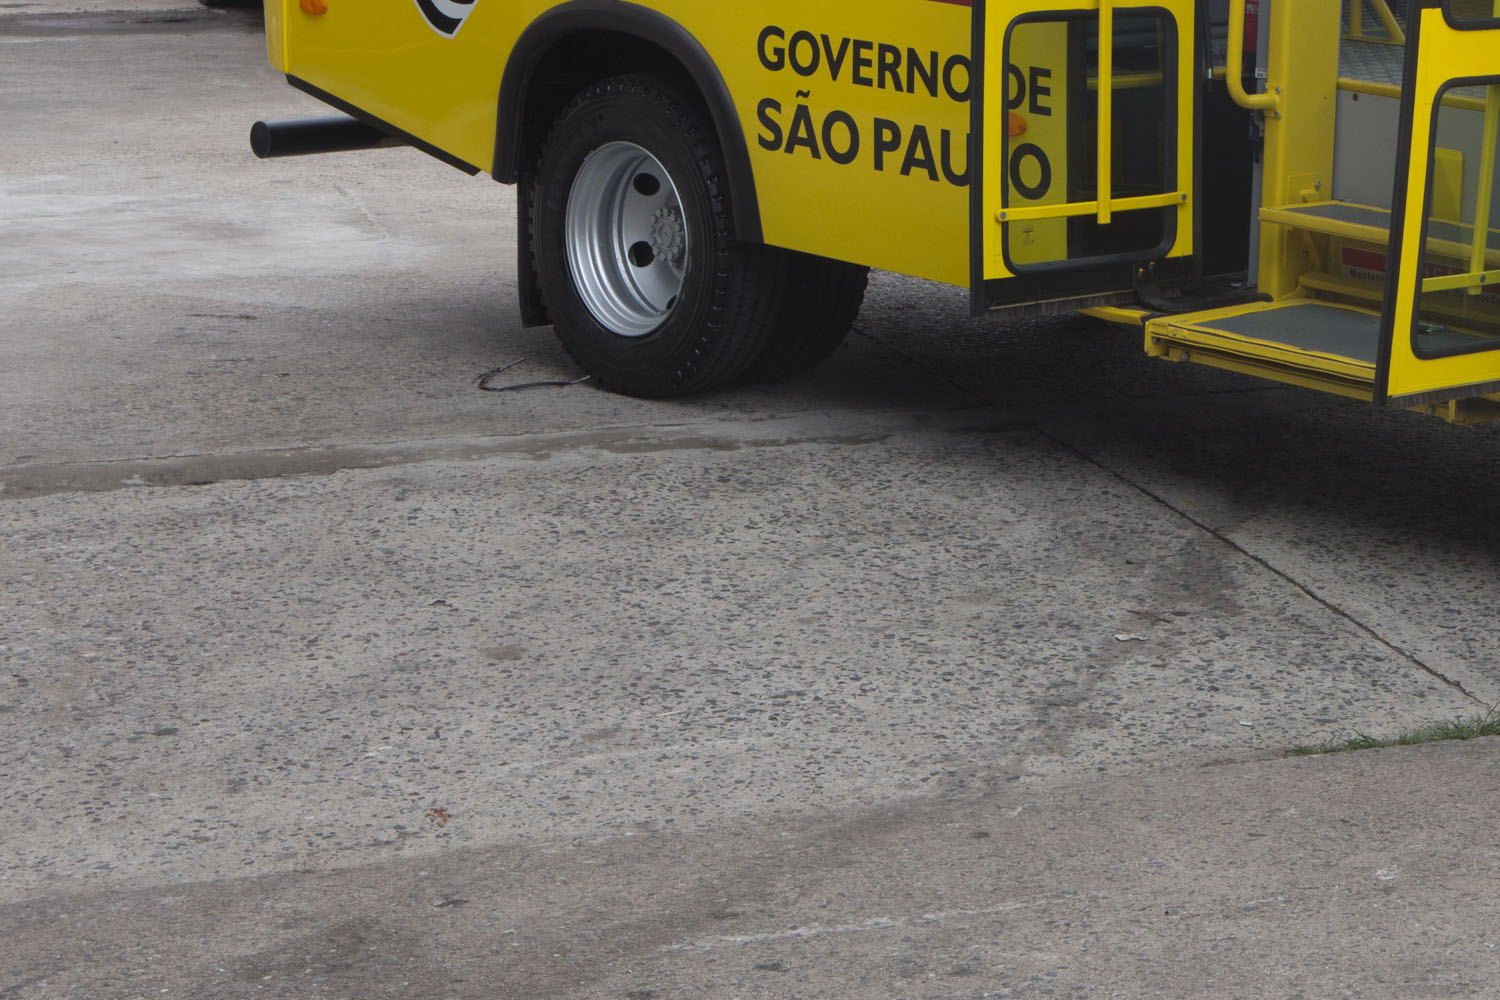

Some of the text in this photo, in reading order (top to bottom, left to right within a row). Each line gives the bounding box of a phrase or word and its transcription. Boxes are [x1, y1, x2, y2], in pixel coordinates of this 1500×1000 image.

[756, 25, 972, 103] GOVERNO
[756, 89, 1052, 201] SÃO PAUO
